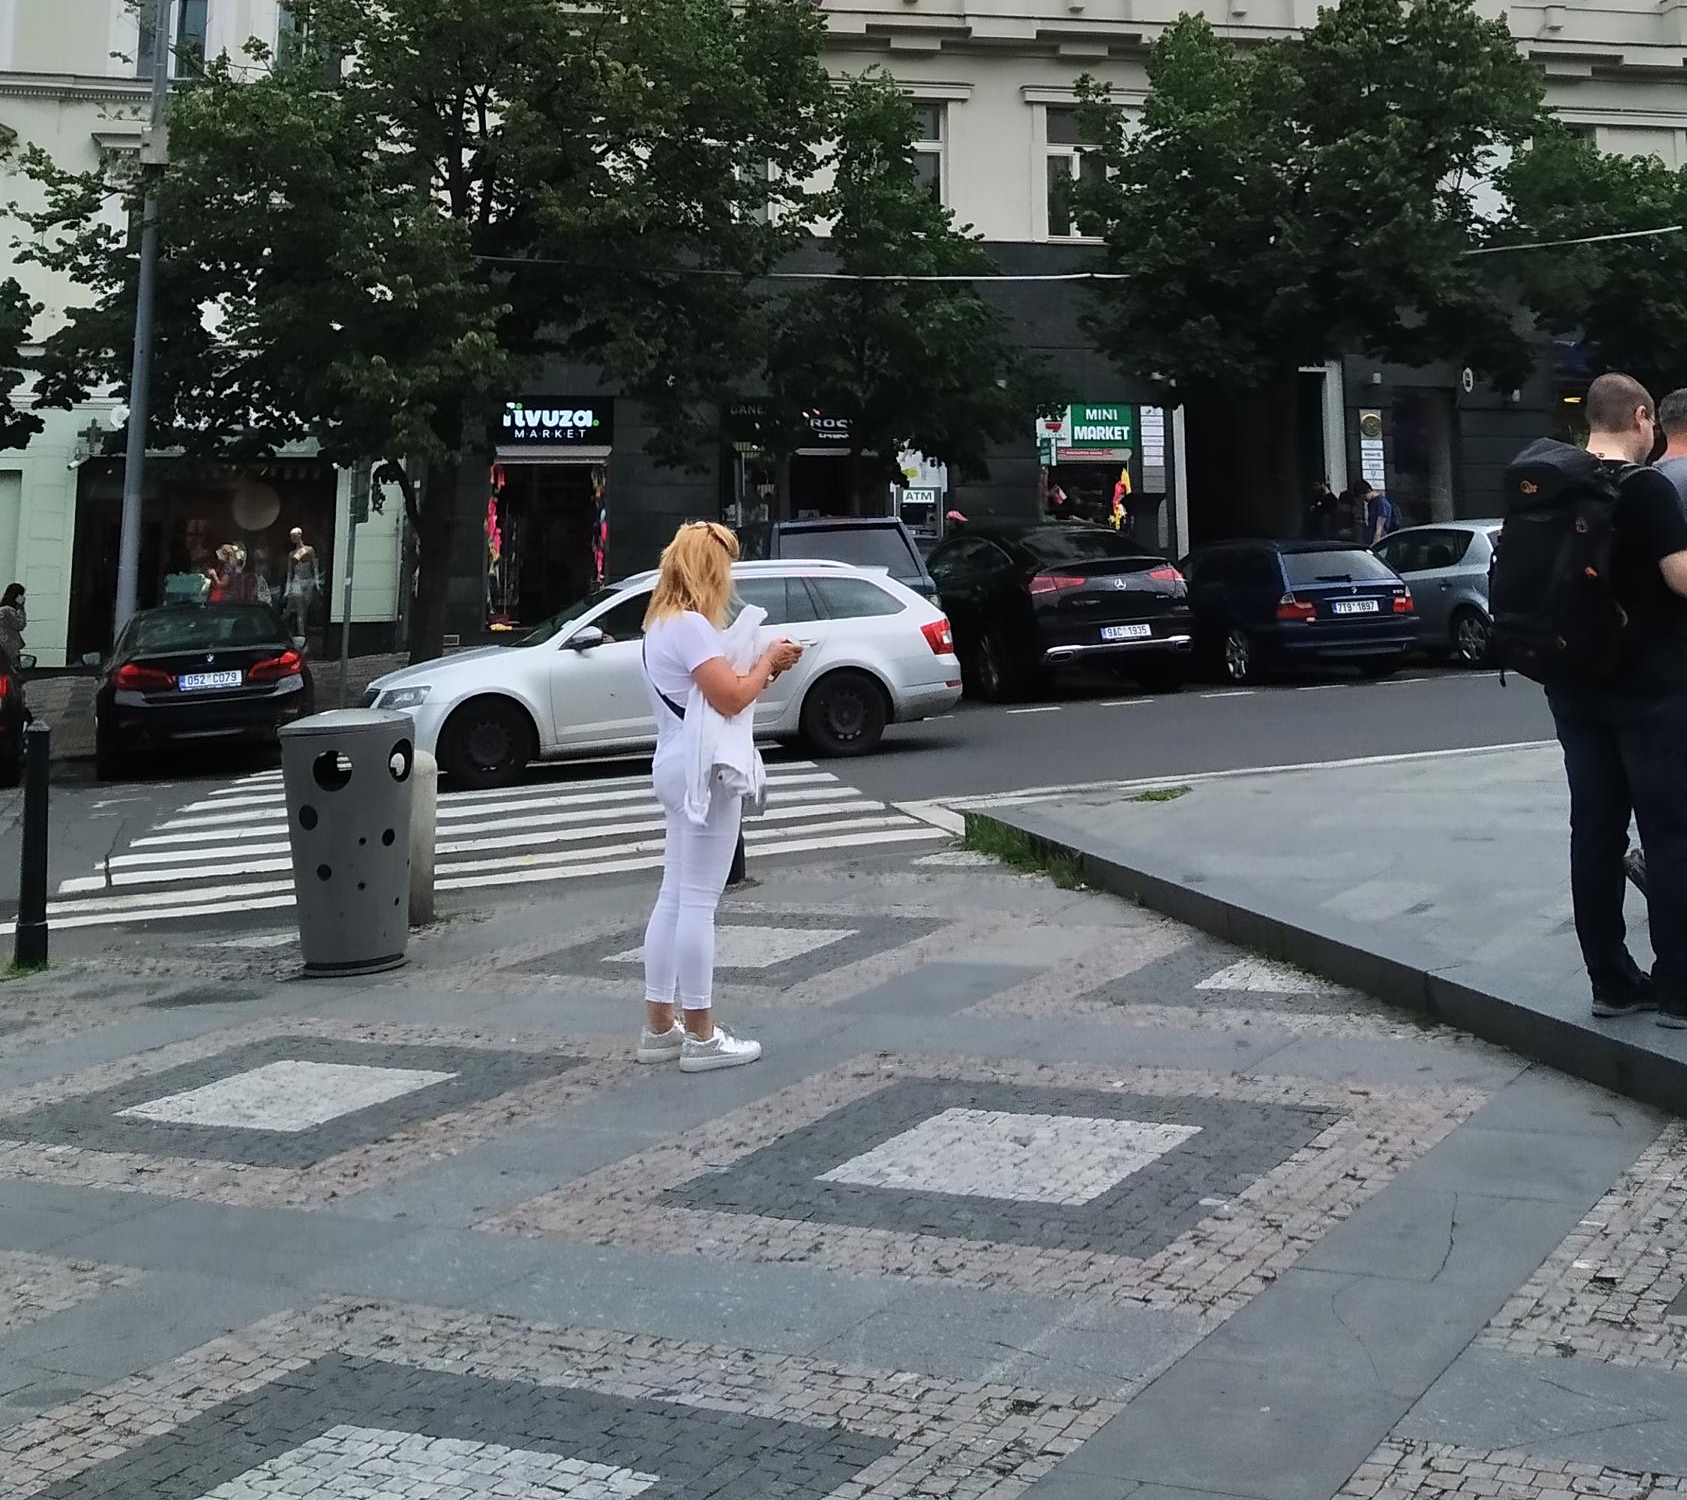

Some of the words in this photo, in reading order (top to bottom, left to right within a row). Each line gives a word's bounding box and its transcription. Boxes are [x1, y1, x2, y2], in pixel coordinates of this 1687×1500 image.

[1086, 409, 1118, 420] MINI
[1074, 426, 1130, 440] MARKET
[905, 492, 932, 501] ATM
